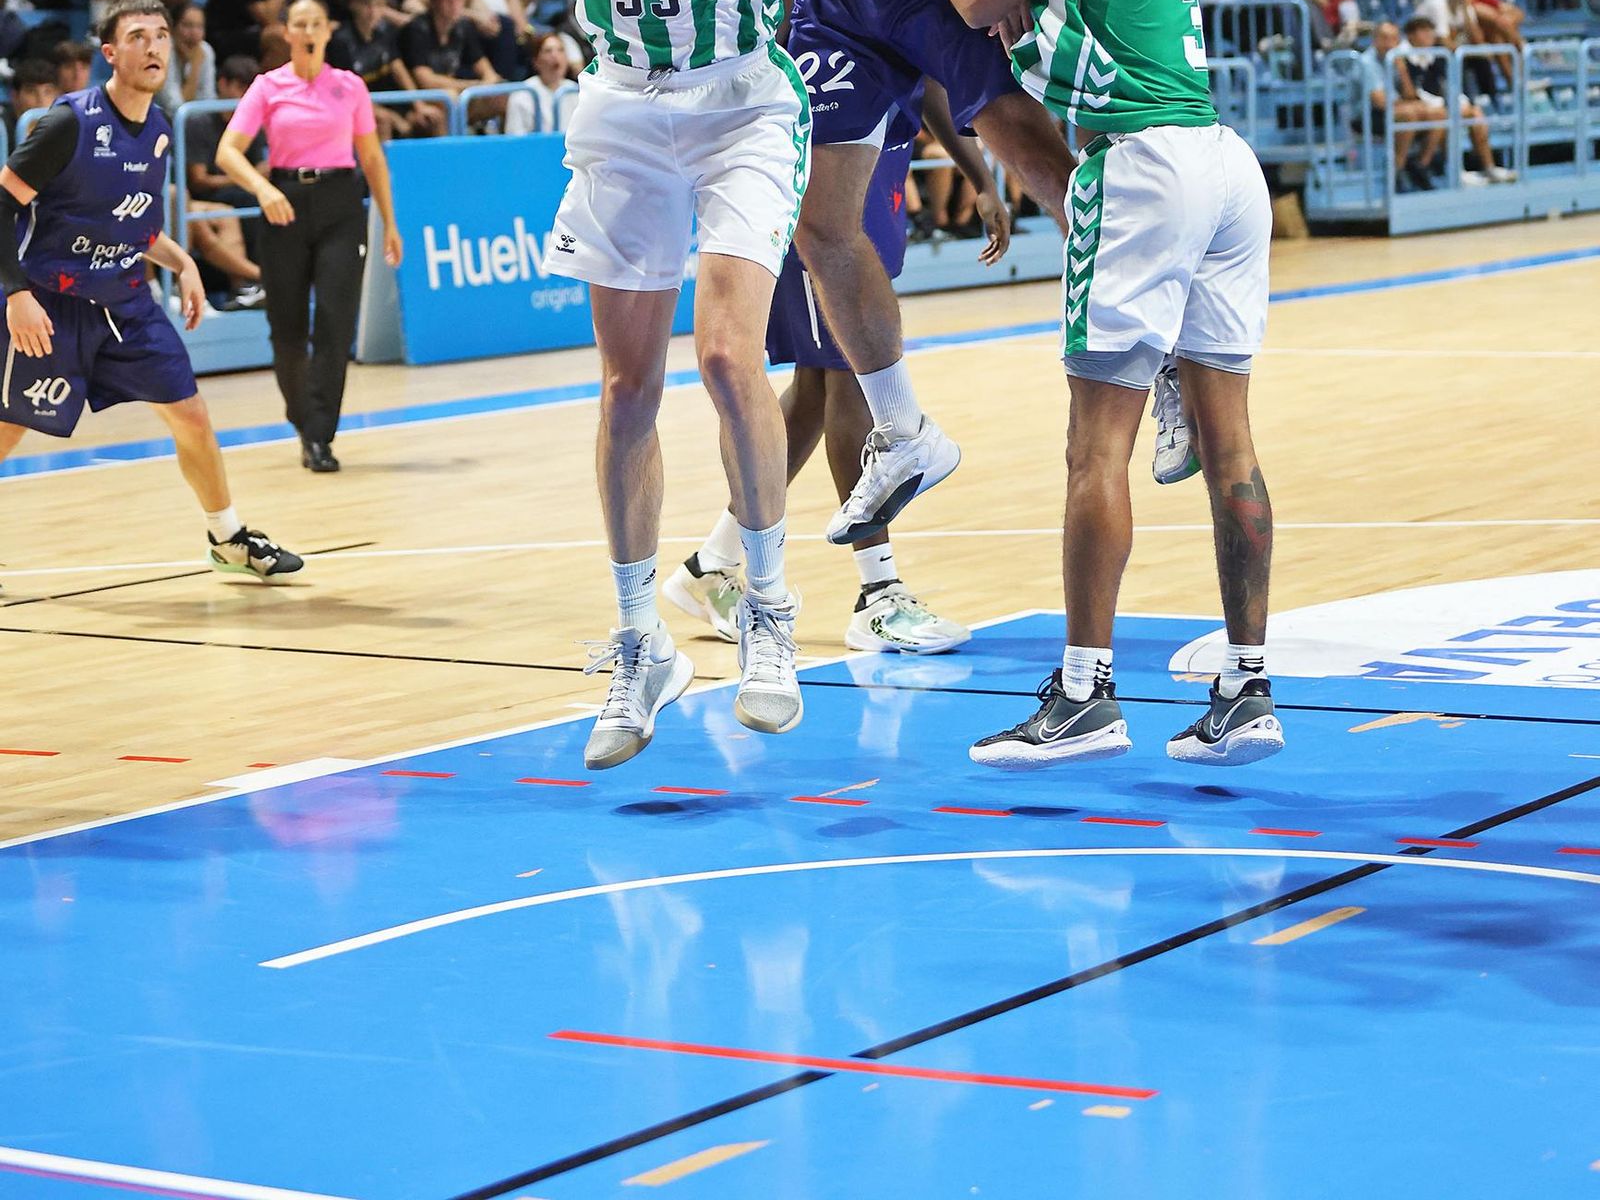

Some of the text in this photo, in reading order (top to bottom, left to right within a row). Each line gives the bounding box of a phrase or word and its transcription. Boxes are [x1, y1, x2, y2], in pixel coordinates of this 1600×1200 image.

[795, 50, 856, 94] 22
[112, 191, 153, 222] 40
[422, 216, 552, 291] Huelv
[23, 376, 71, 407] 40
